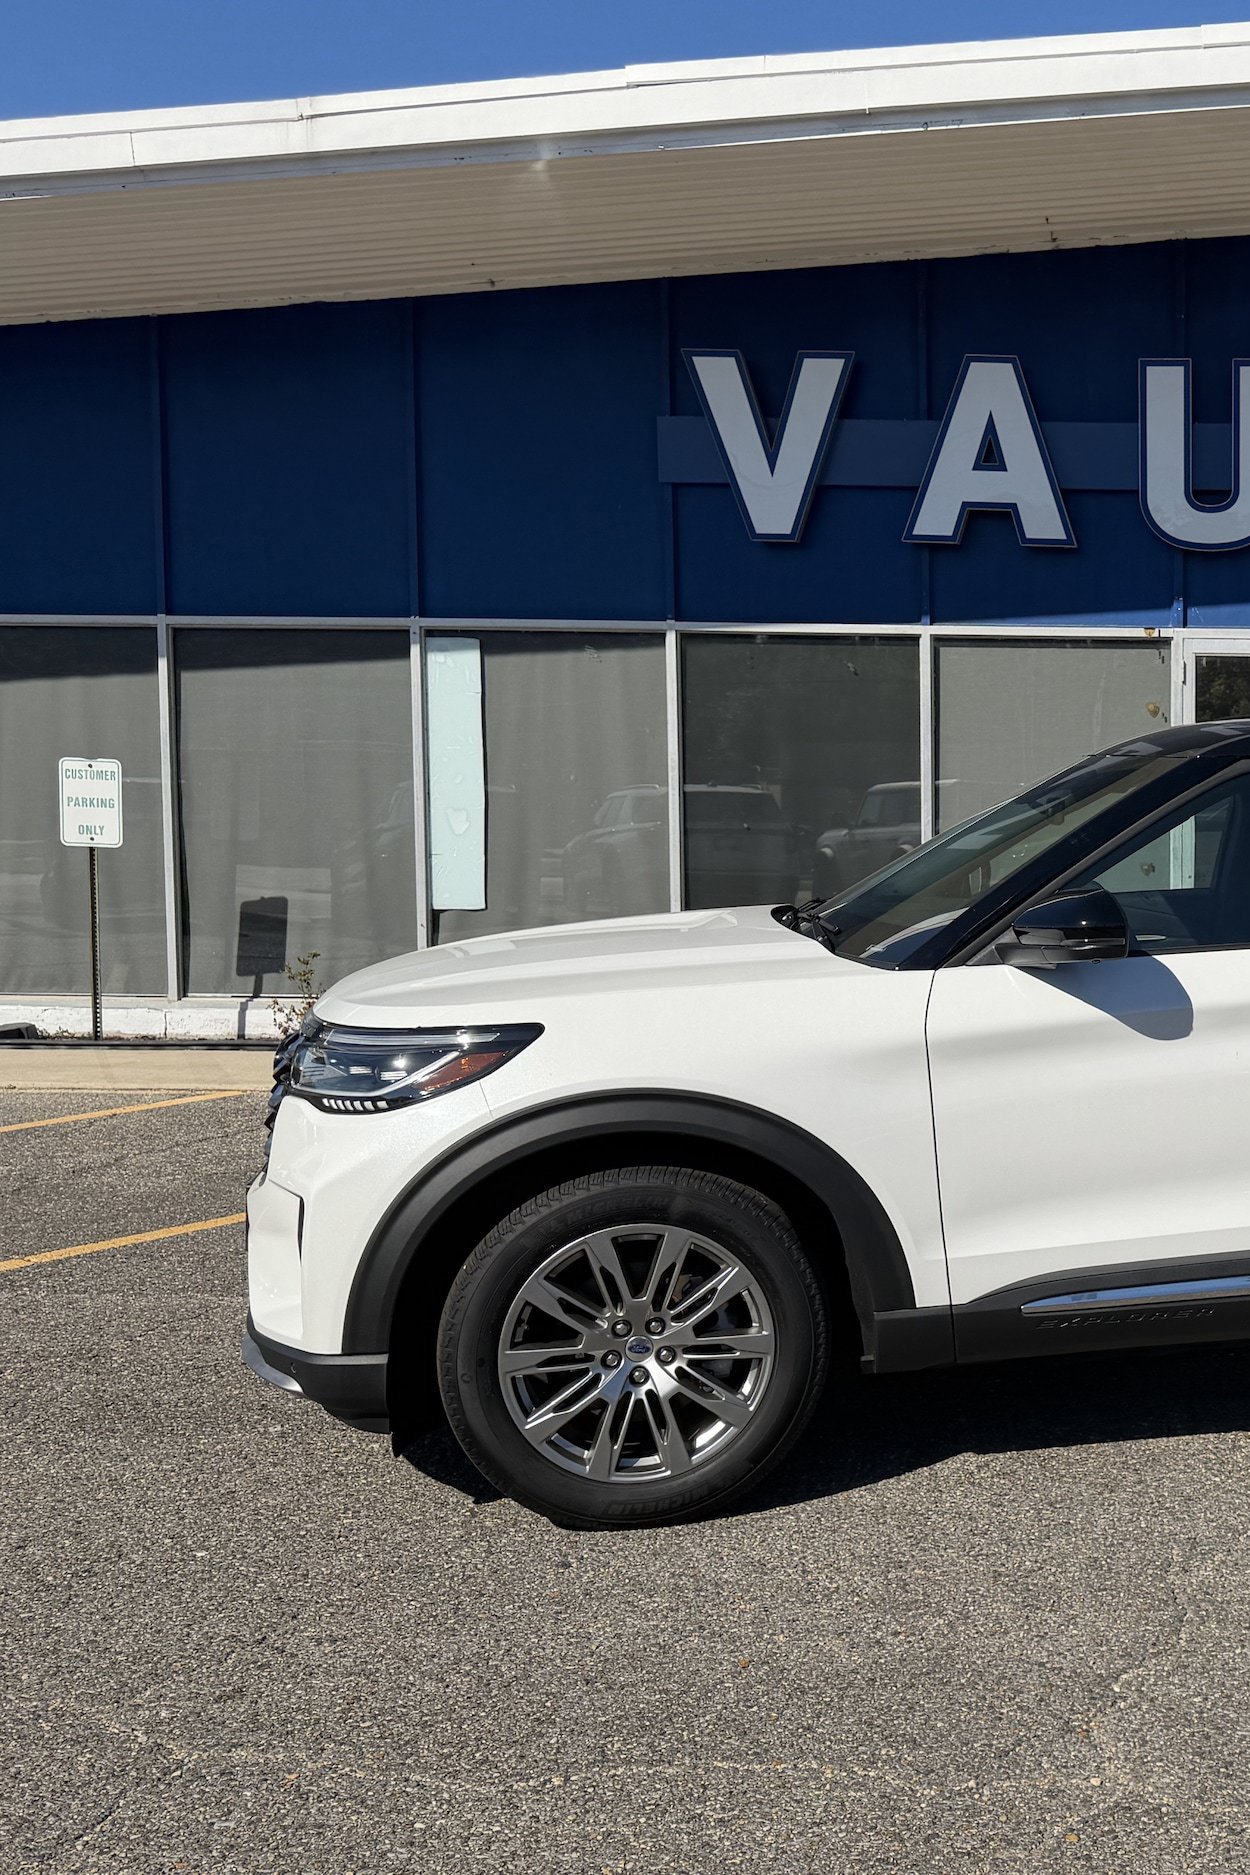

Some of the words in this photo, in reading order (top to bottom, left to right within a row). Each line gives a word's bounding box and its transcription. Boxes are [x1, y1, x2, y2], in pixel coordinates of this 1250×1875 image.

[64, 768, 116, 782] CUSTOMER
[67, 796, 115, 809] PARKING
[78, 824, 105, 836] ONLY
[1036, 1304, 1216, 1329] EXPLORER
